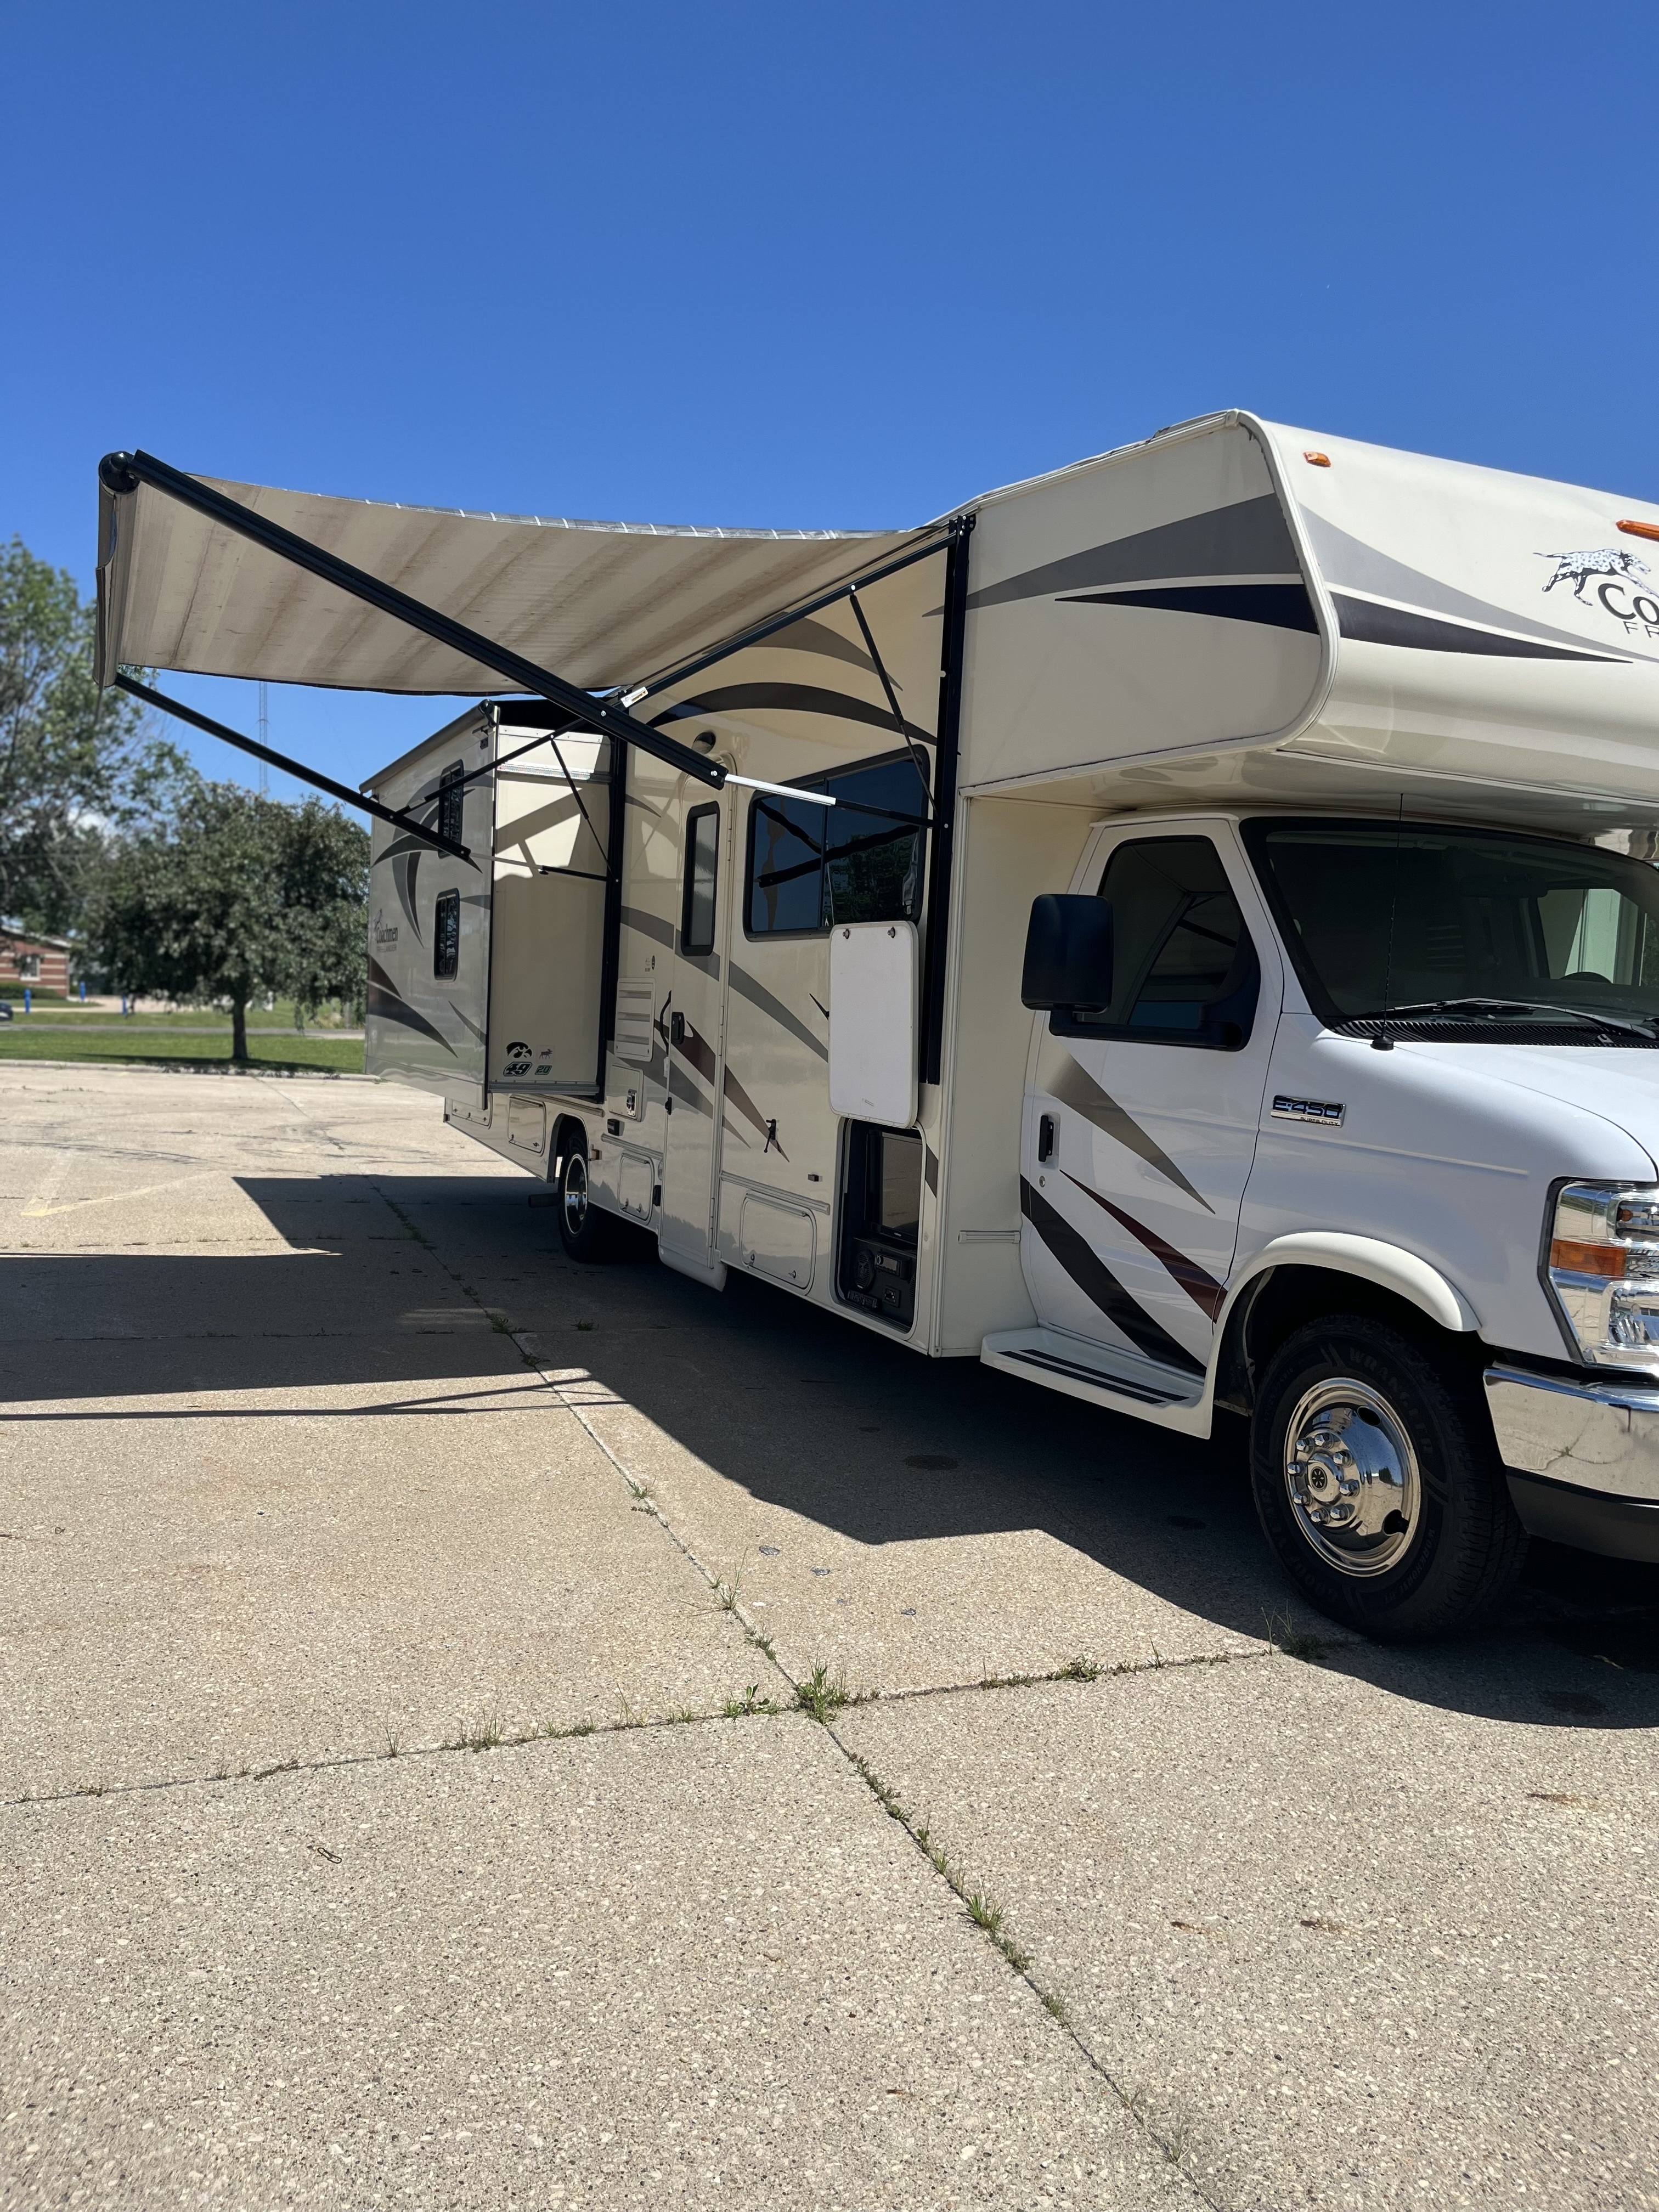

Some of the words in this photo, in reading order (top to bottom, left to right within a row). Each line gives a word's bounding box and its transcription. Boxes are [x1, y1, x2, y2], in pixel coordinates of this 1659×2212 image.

[376, 923, 398, 943] Coachmen
[535, 1065, 551, 1074] 20
[1350, 1347, 1433, 1454] WRANGLER
